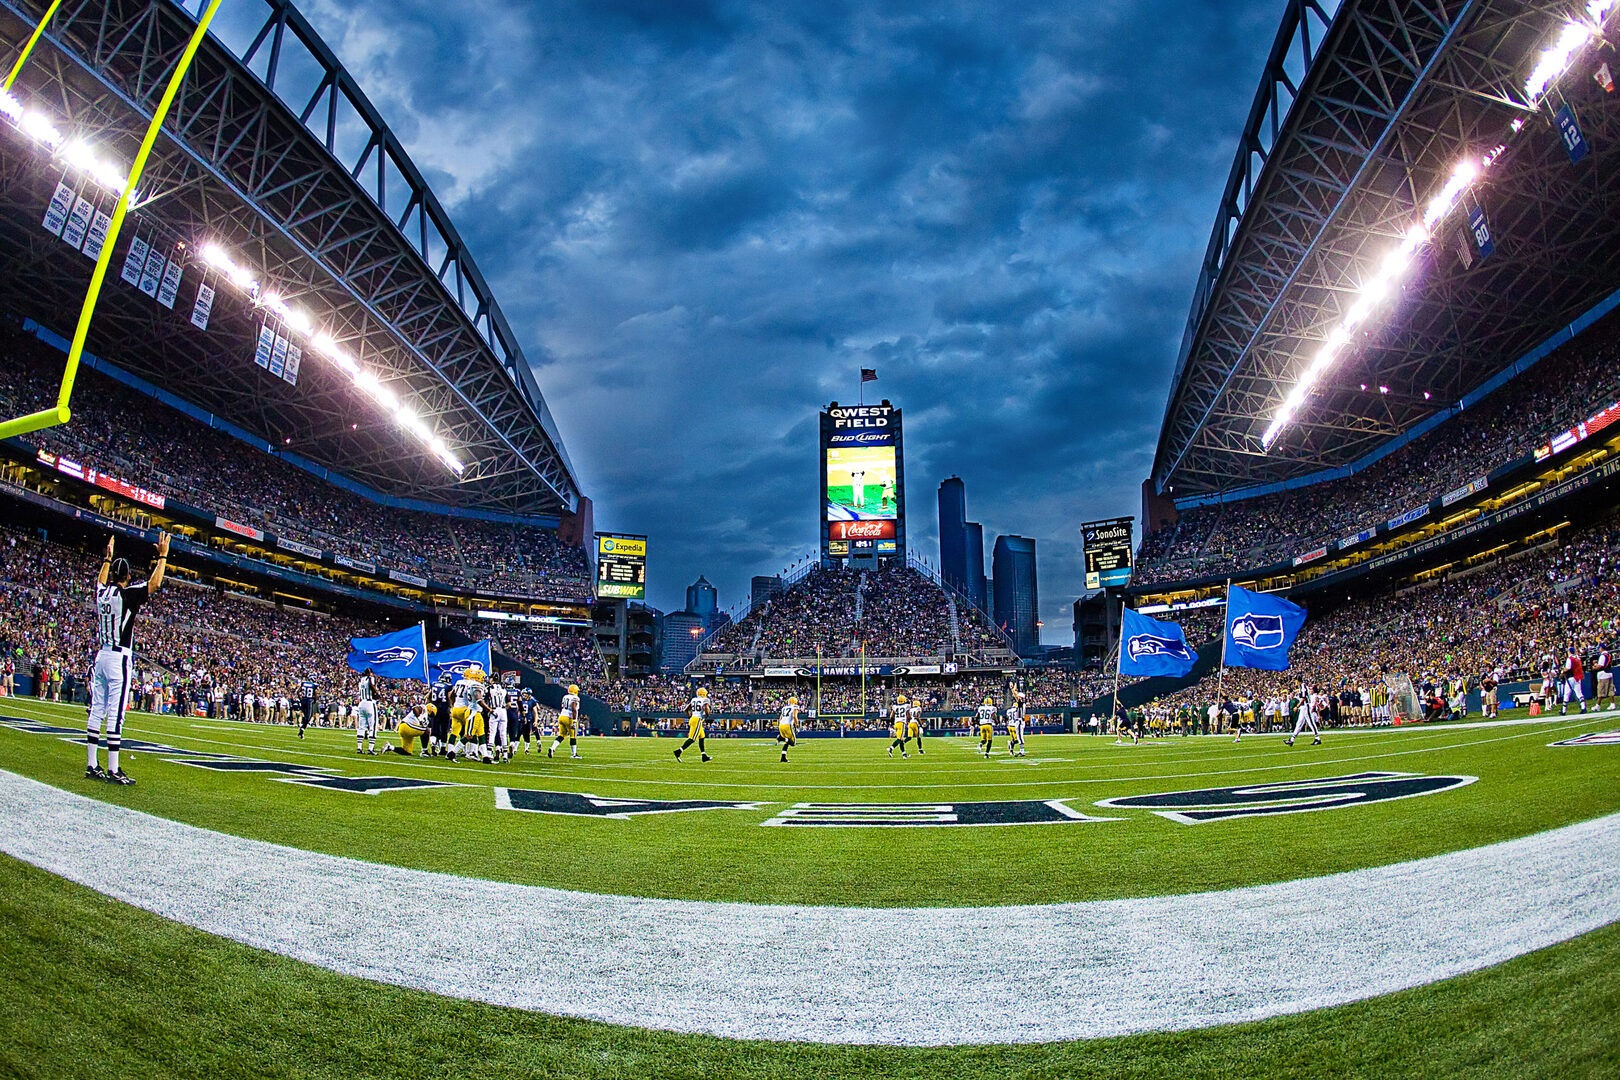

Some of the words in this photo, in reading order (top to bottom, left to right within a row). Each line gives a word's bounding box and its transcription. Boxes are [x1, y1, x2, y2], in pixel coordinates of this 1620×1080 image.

[1563, 124, 1581, 152] 12
[1475, 223, 1490, 247] 80
[830, 407, 892, 419] QWEST
[835, 418, 888, 429] FIELD
[1545, 490, 1557, 502] STEVE
[1557, 483, 1573, 496] LARGENT
[1095, 526, 1128, 540] SonoSite
[615, 543, 643, 552] Expedia
[602, 584, 643, 596] SUBWAY
[100, 603, 112, 615] 30
[823, 667, 855, 676] HAWKS
[858, 667, 881, 676] NEST
[431, 688, 447, 703] 64
[454, 684, 466, 698] 77
[892, 704, 903, 713] 42
[967, 705, 977, 715] 36
